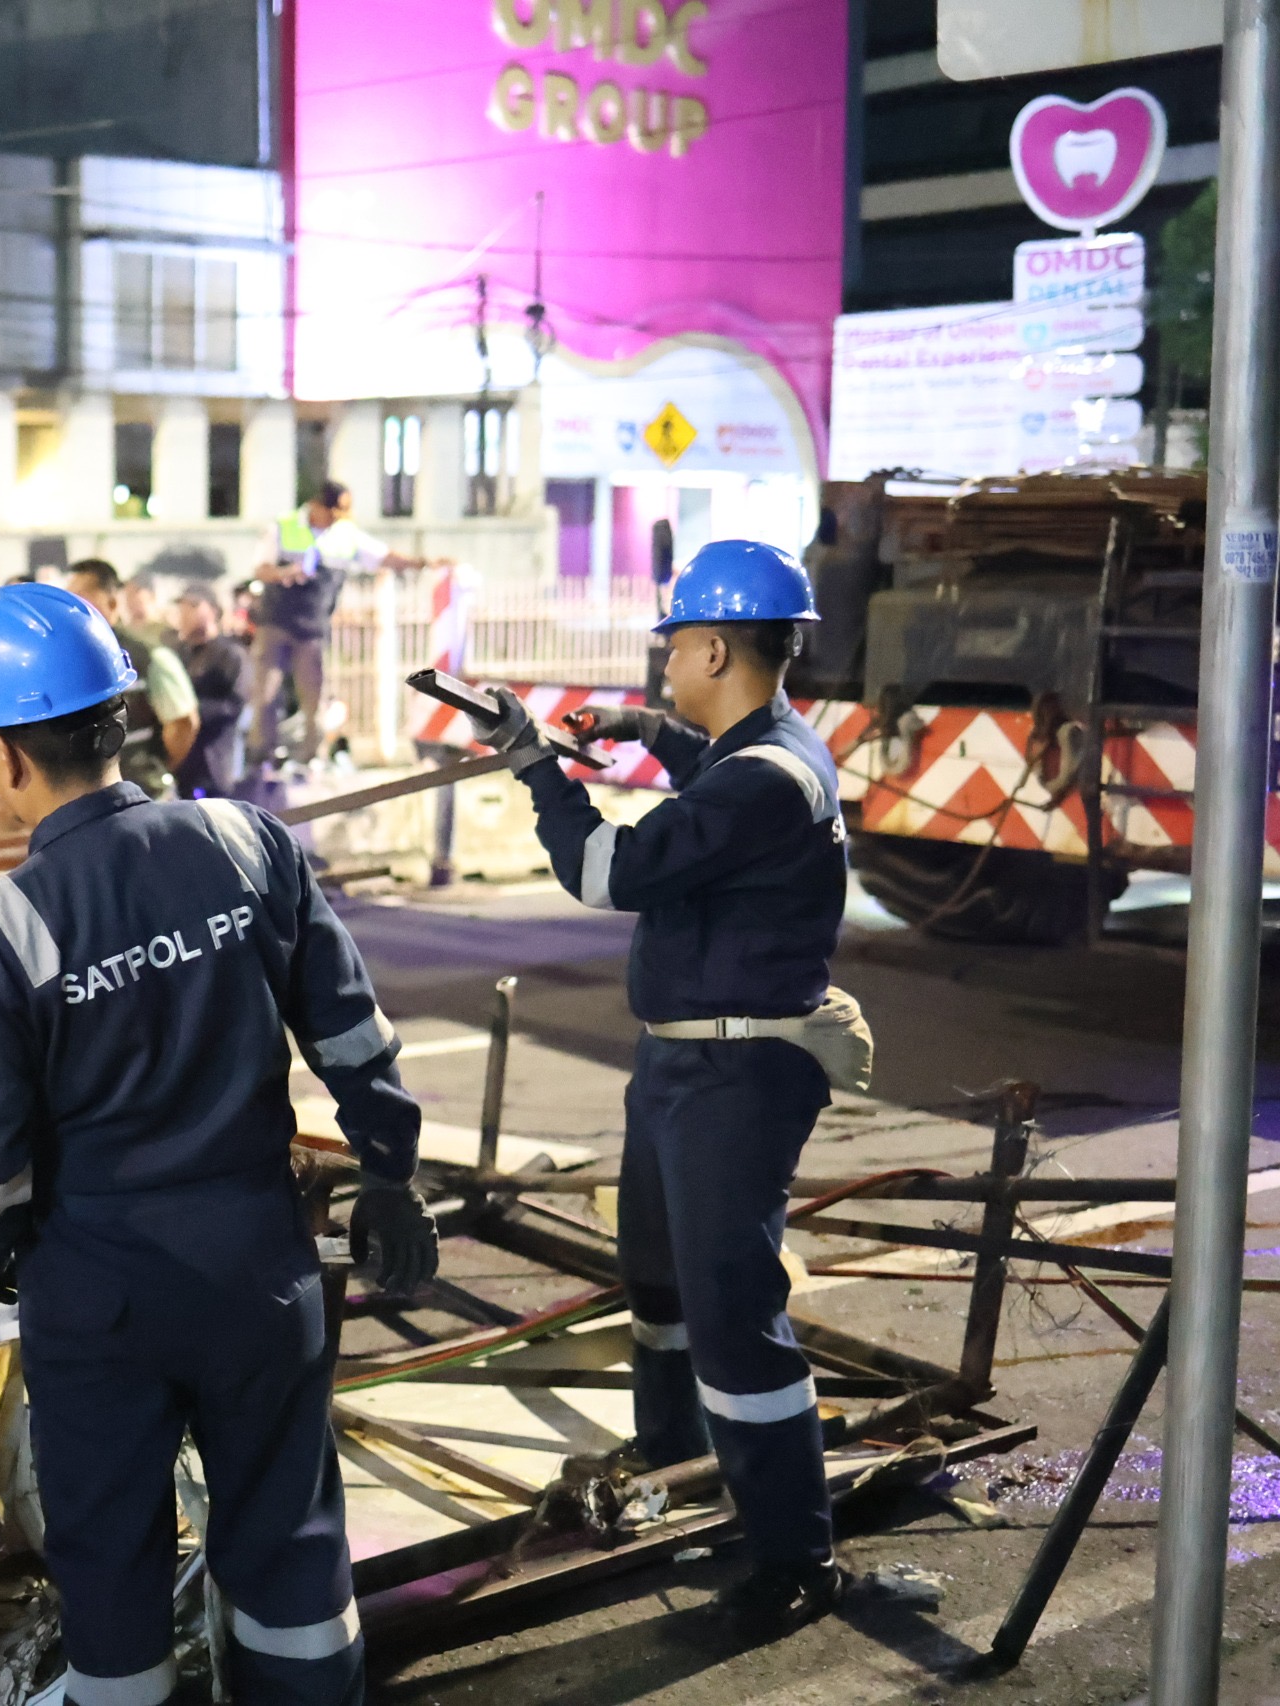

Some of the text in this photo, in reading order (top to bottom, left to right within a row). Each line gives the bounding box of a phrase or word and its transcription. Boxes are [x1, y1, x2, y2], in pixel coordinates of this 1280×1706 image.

[492, 0, 708, 77] OMDC
[488, 62, 708, 157] GROUP
[1026, 245, 1133, 277] OMDC
[1027, 279, 1131, 302] DENTAL
[61, 905, 255, 1005] SATPOL PP
